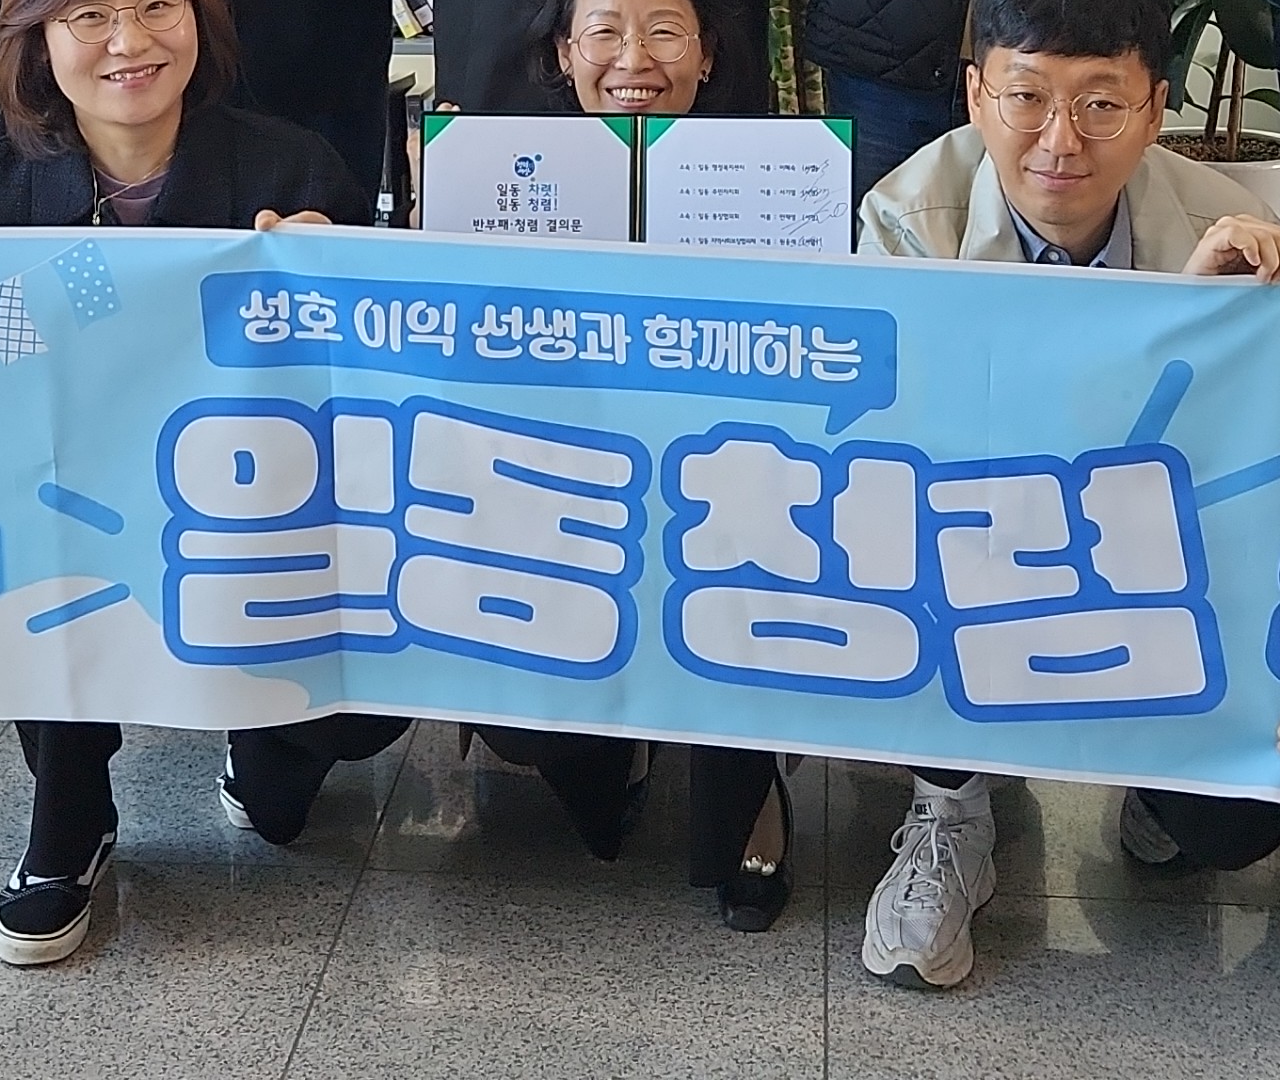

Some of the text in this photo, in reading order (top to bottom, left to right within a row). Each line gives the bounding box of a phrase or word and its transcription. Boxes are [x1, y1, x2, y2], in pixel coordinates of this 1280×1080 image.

[497, 184, 557, 197] 일동 차렷!
[497, 198, 557, 212] 일동 청렴!
[473, 219, 582, 232] 반부패·청렴 결의문
[239, 289, 871, 388] 성호 이익 선생과 함께하는
[168, 404, 1216, 715] 일동 청렴
